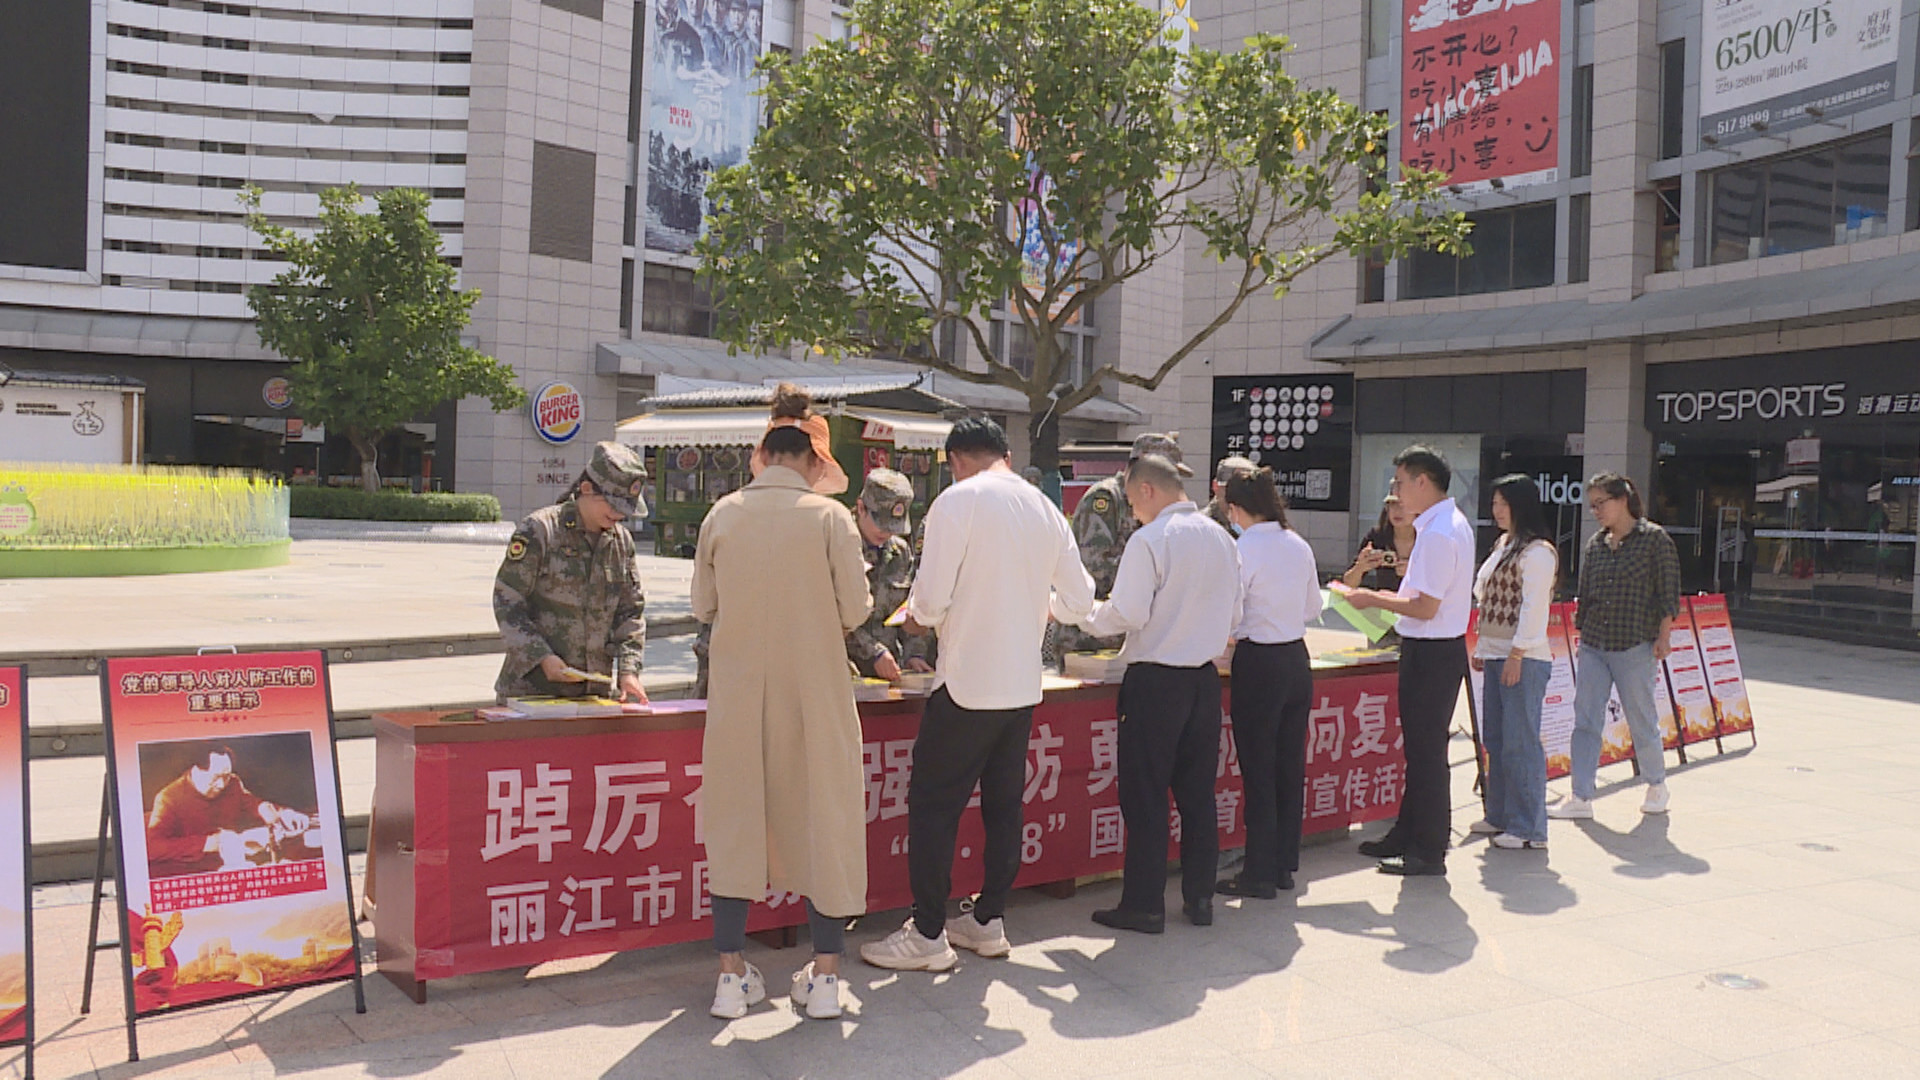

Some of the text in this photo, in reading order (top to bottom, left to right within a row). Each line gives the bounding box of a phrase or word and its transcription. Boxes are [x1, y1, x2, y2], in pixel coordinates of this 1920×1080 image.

[1717, 118, 1737, 135] 517
[540, 393, 579, 414] BURGER
[1231, 389, 1246, 402] 1F
[1657, 383, 1846, 422] TOPSPORTS
[541, 405, 580, 428] KING
[1228, 435, 1244, 448] 2F
[537, 473, 570, 484] SINCE
[122, 666, 316, 695] 党的领导人对人防工作的
[188, 690, 260, 712] 重要指示
